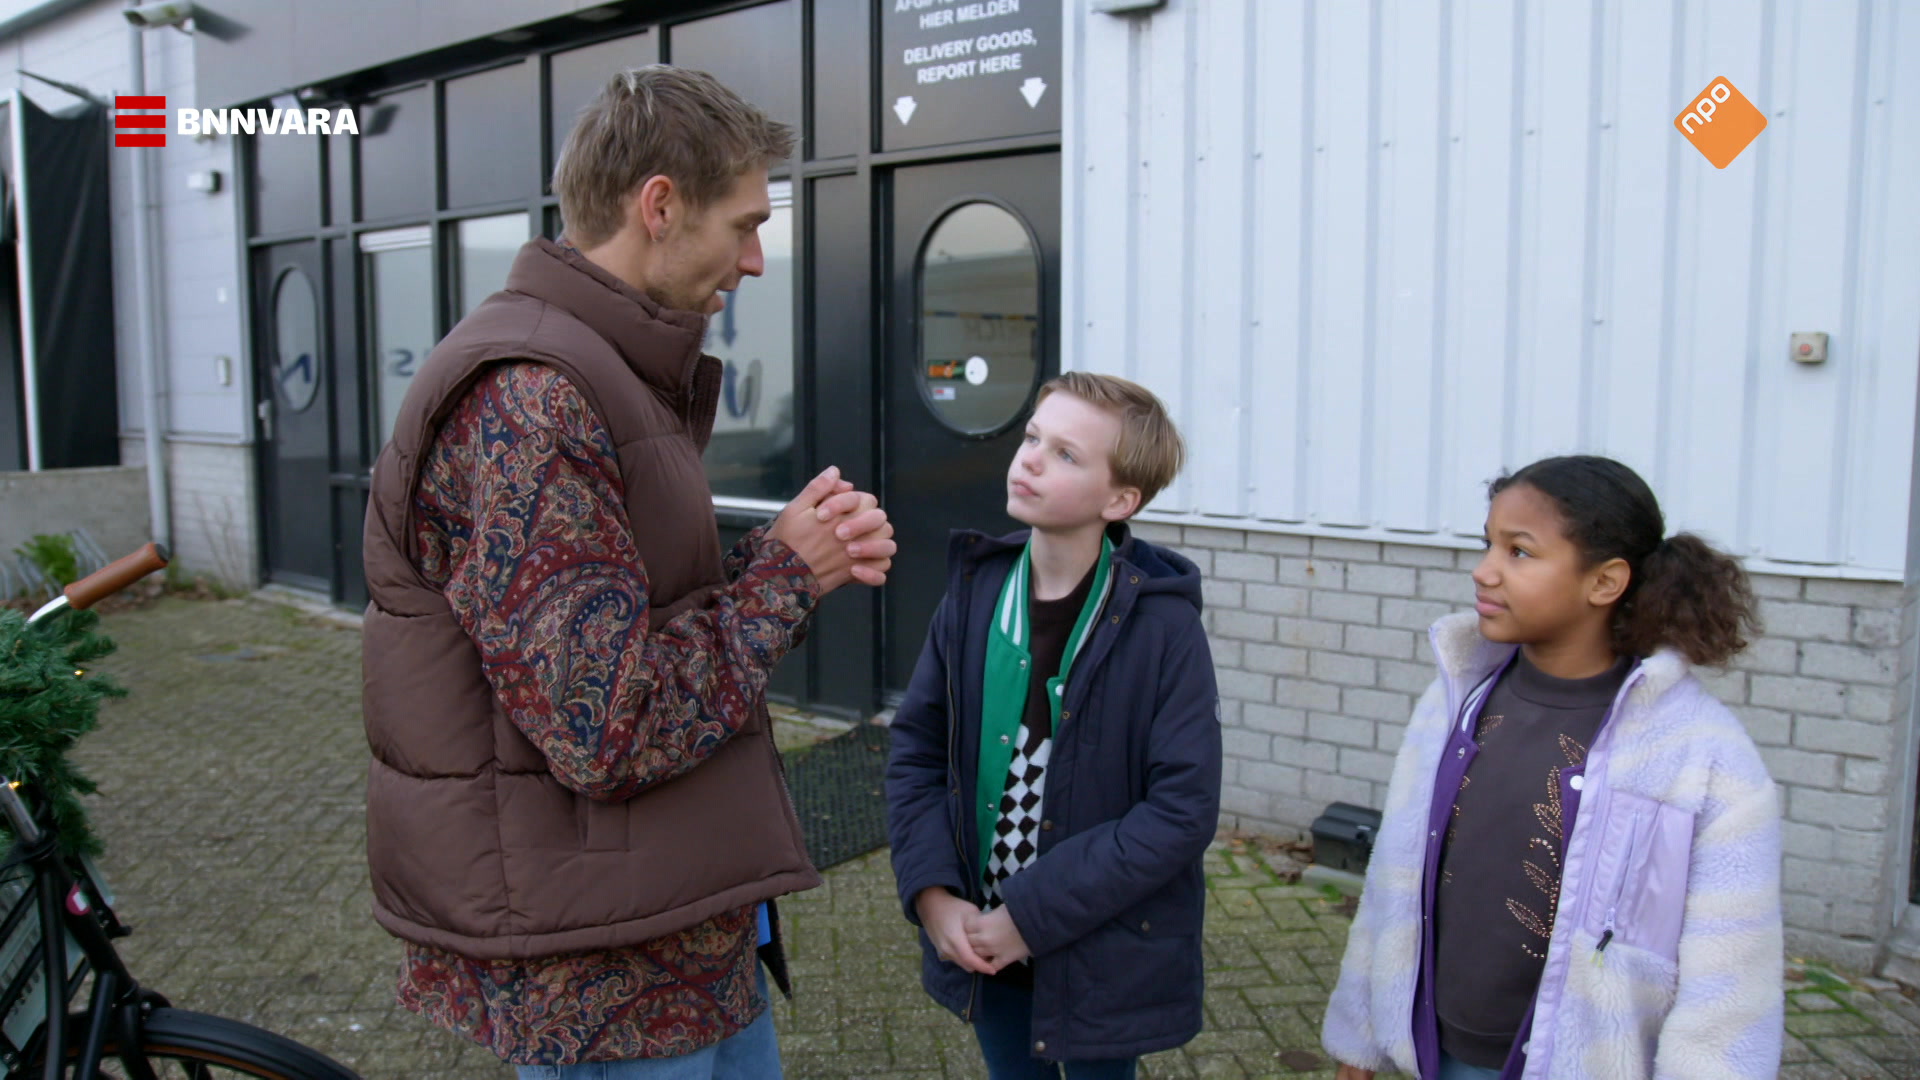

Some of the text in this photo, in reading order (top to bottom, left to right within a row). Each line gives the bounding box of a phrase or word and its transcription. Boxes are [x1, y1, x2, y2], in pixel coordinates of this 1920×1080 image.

[919, 0, 1020, 30] HIER MELDEN
[903, 28, 1037, 65] DELIVERY GOODS,
[917, 53, 1022, 84] REPORT HERE
